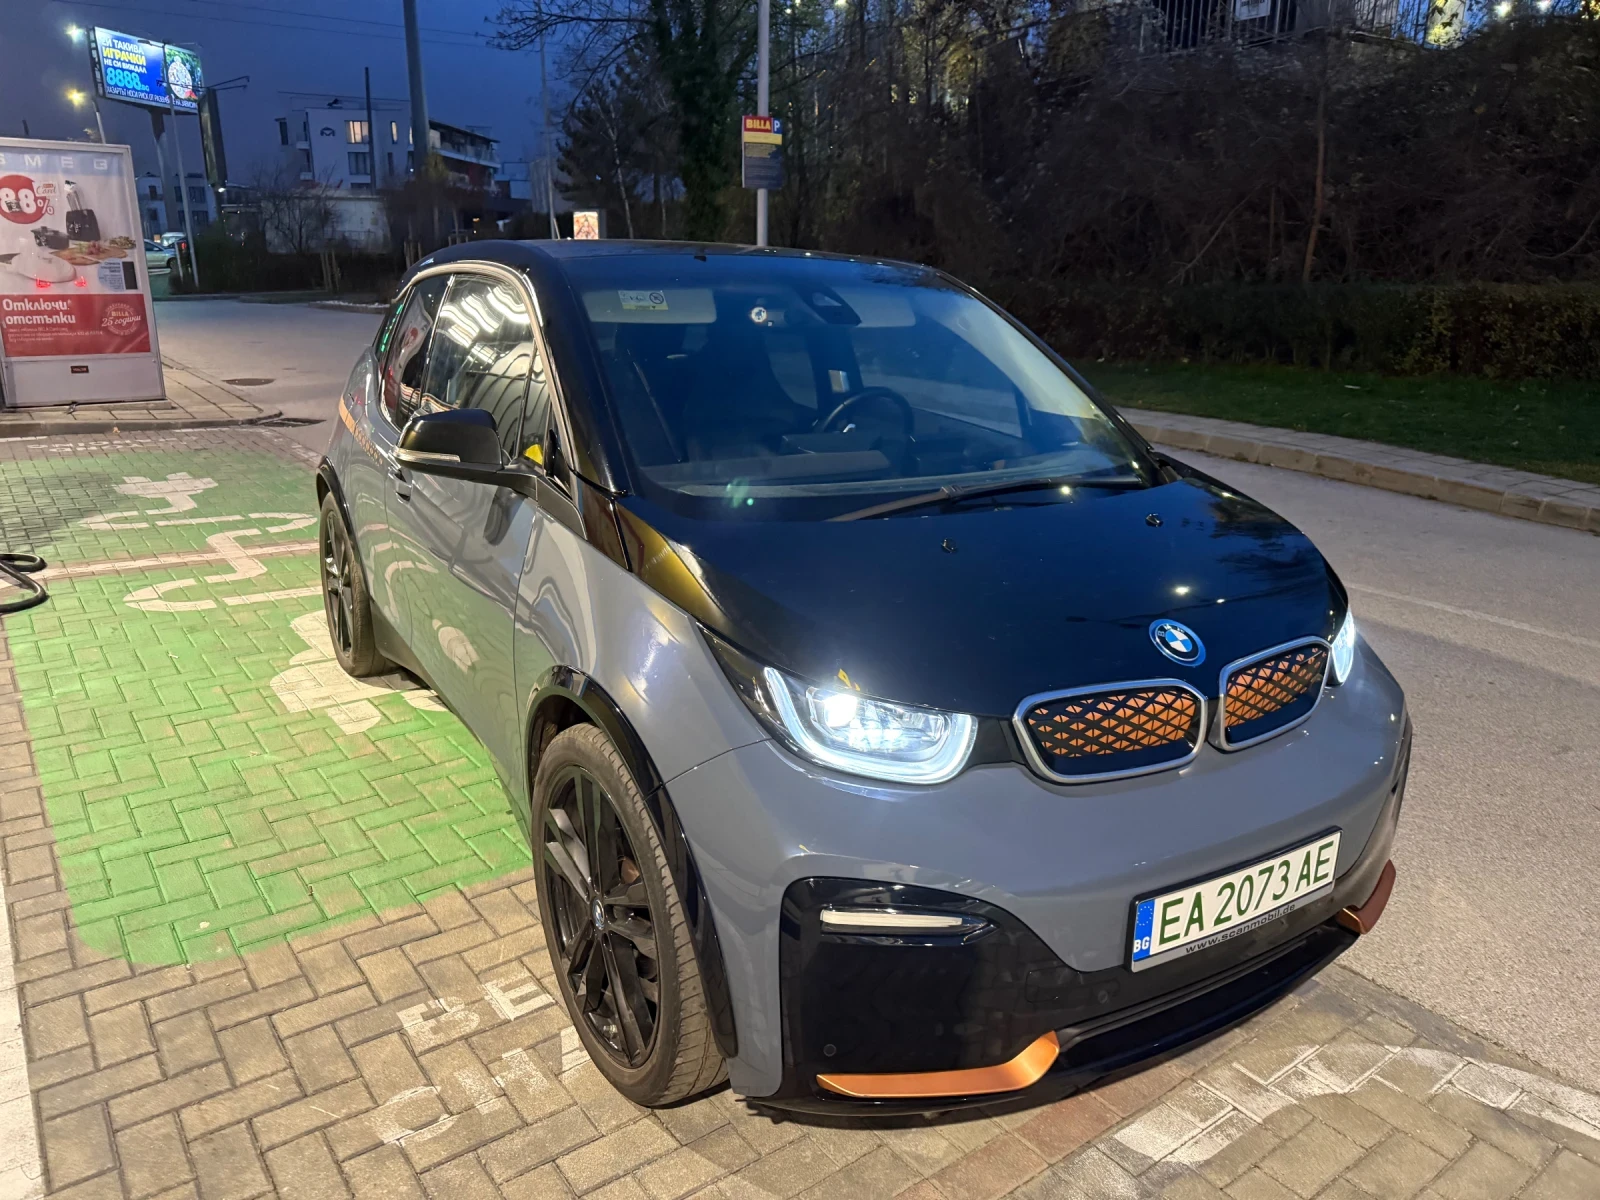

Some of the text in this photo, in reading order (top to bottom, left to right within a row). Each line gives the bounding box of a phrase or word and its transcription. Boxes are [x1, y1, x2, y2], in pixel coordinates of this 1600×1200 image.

[113, 39, 144, 54] ТАКИВА
[102, 47, 147, 66] ИГРАЧКИ
[104, 58, 112, 66] НЕ
[113, 60, 122, 68] СИ
[746, 119, 771, 130] BILLA
[774, 120, 781, 132] P
[5, 311, 76, 325] отстъпки
[101, 317, 113, 327] 25
[1158, 840, 1334, 945] EA 2073 AE
[1185, 903, 1295, 954] www.scanmobil.de
[1133, 936, 1150, 953] BG
